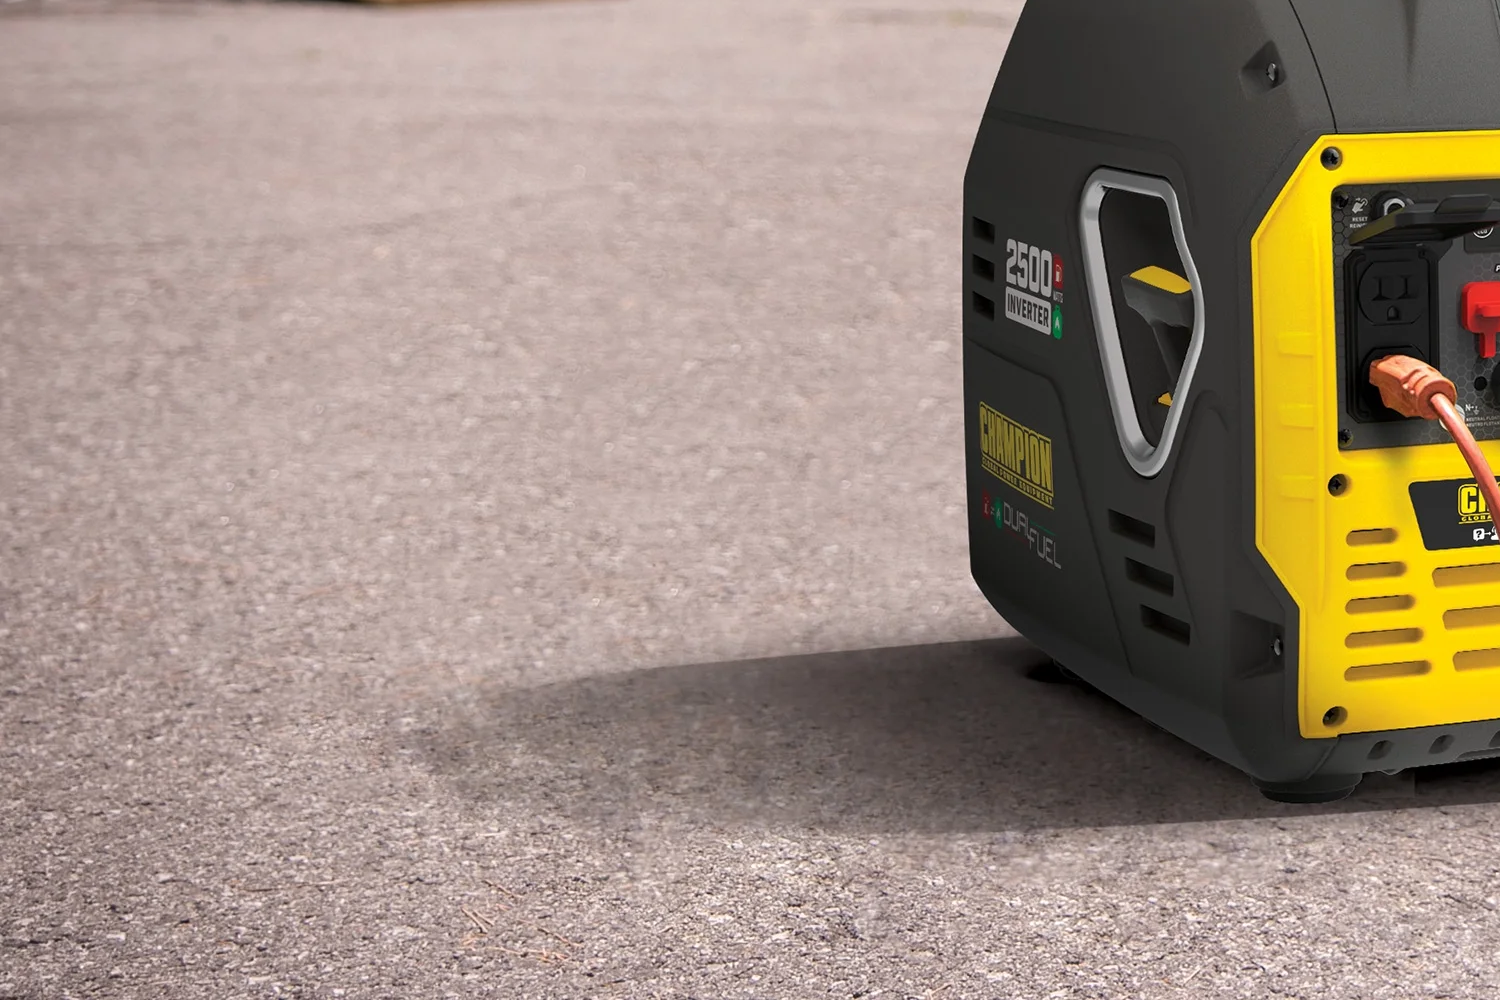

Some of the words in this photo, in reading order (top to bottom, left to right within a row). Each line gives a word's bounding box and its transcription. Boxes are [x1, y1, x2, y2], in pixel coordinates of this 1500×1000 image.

[1006, 238, 1052, 298] 2500
[1007, 293, 1049, 328] INVERTER
[979, 402, 1053, 494] CHAMPION
[982, 456, 999, 475] GLOBAL
[999, 468, 1017, 486] POWER
[1019, 479, 1053, 506] EQUIPMENT
[1461, 514, 1495, 522] GLOBA
